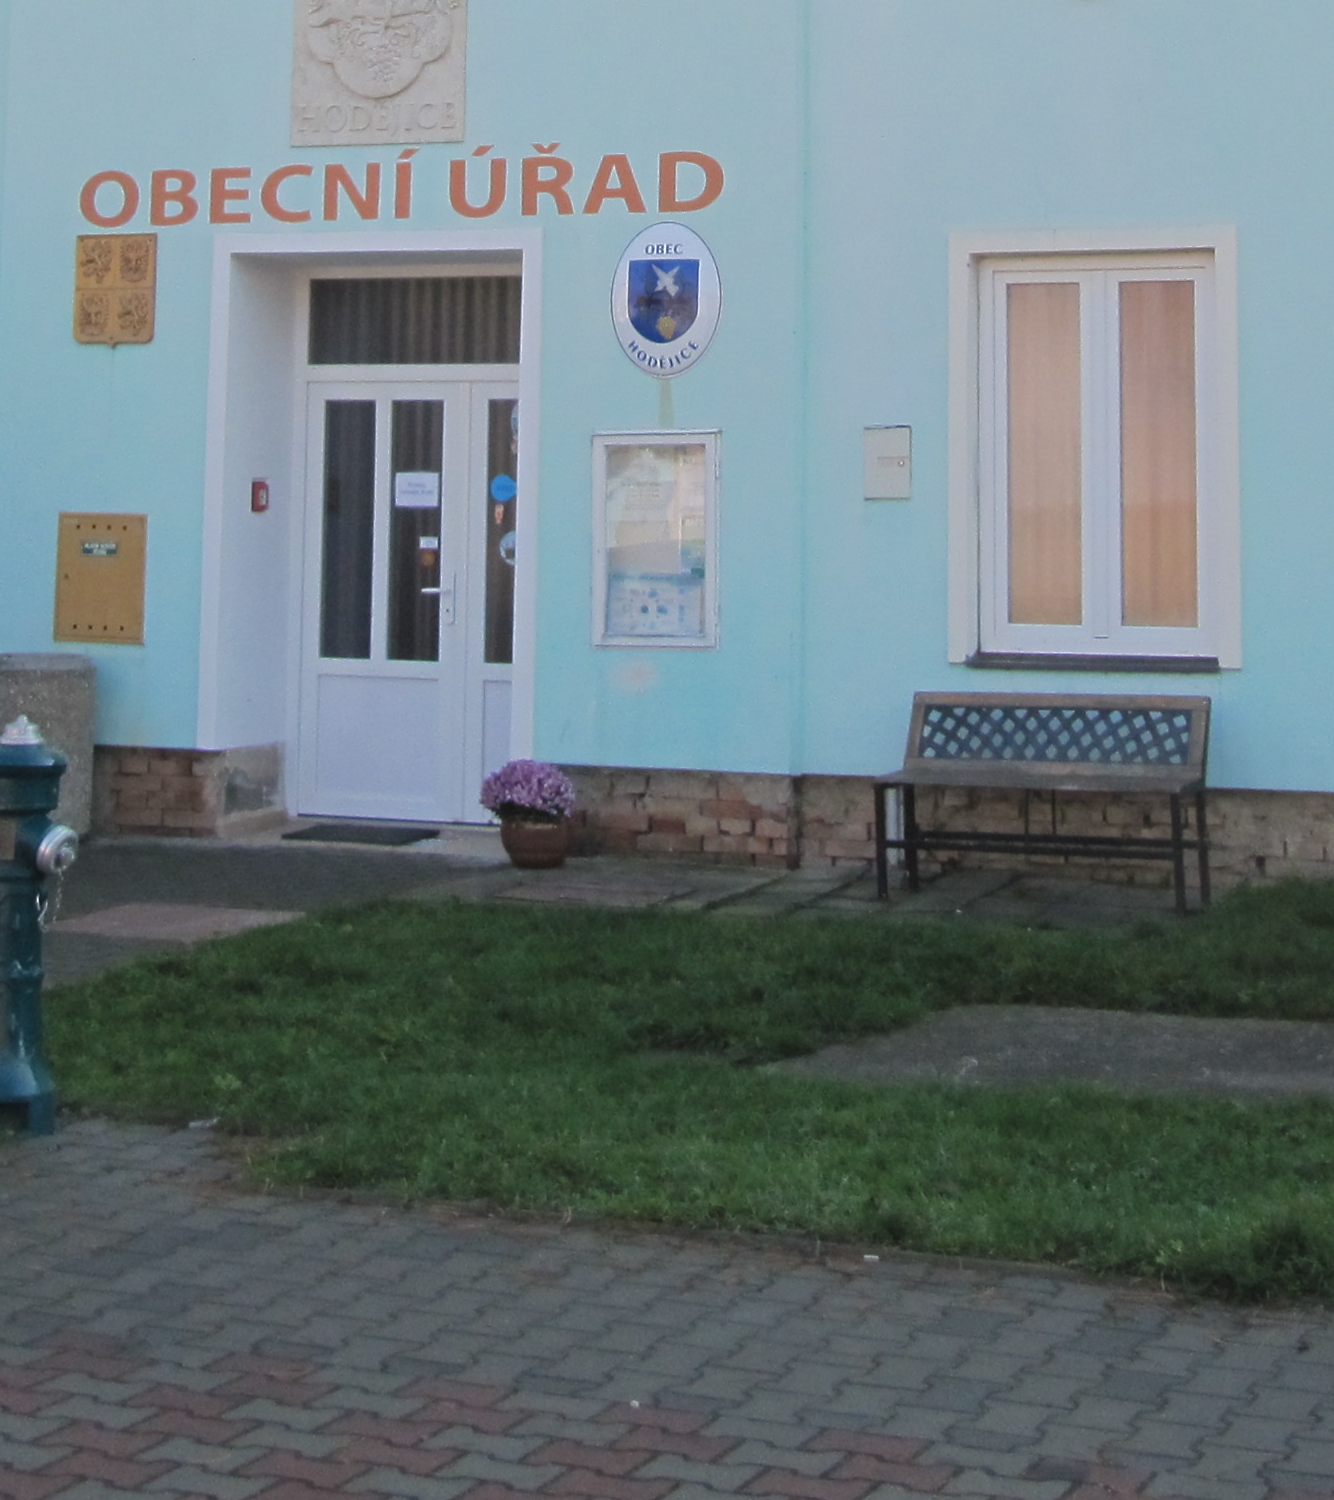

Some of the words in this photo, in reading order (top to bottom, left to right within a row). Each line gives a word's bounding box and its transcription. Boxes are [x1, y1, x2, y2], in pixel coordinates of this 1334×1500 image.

[81, 149, 415, 227] OBECNÍ
[451, 143, 723, 218] ÚŘAD
[645, 243, 683, 256] OBEC
